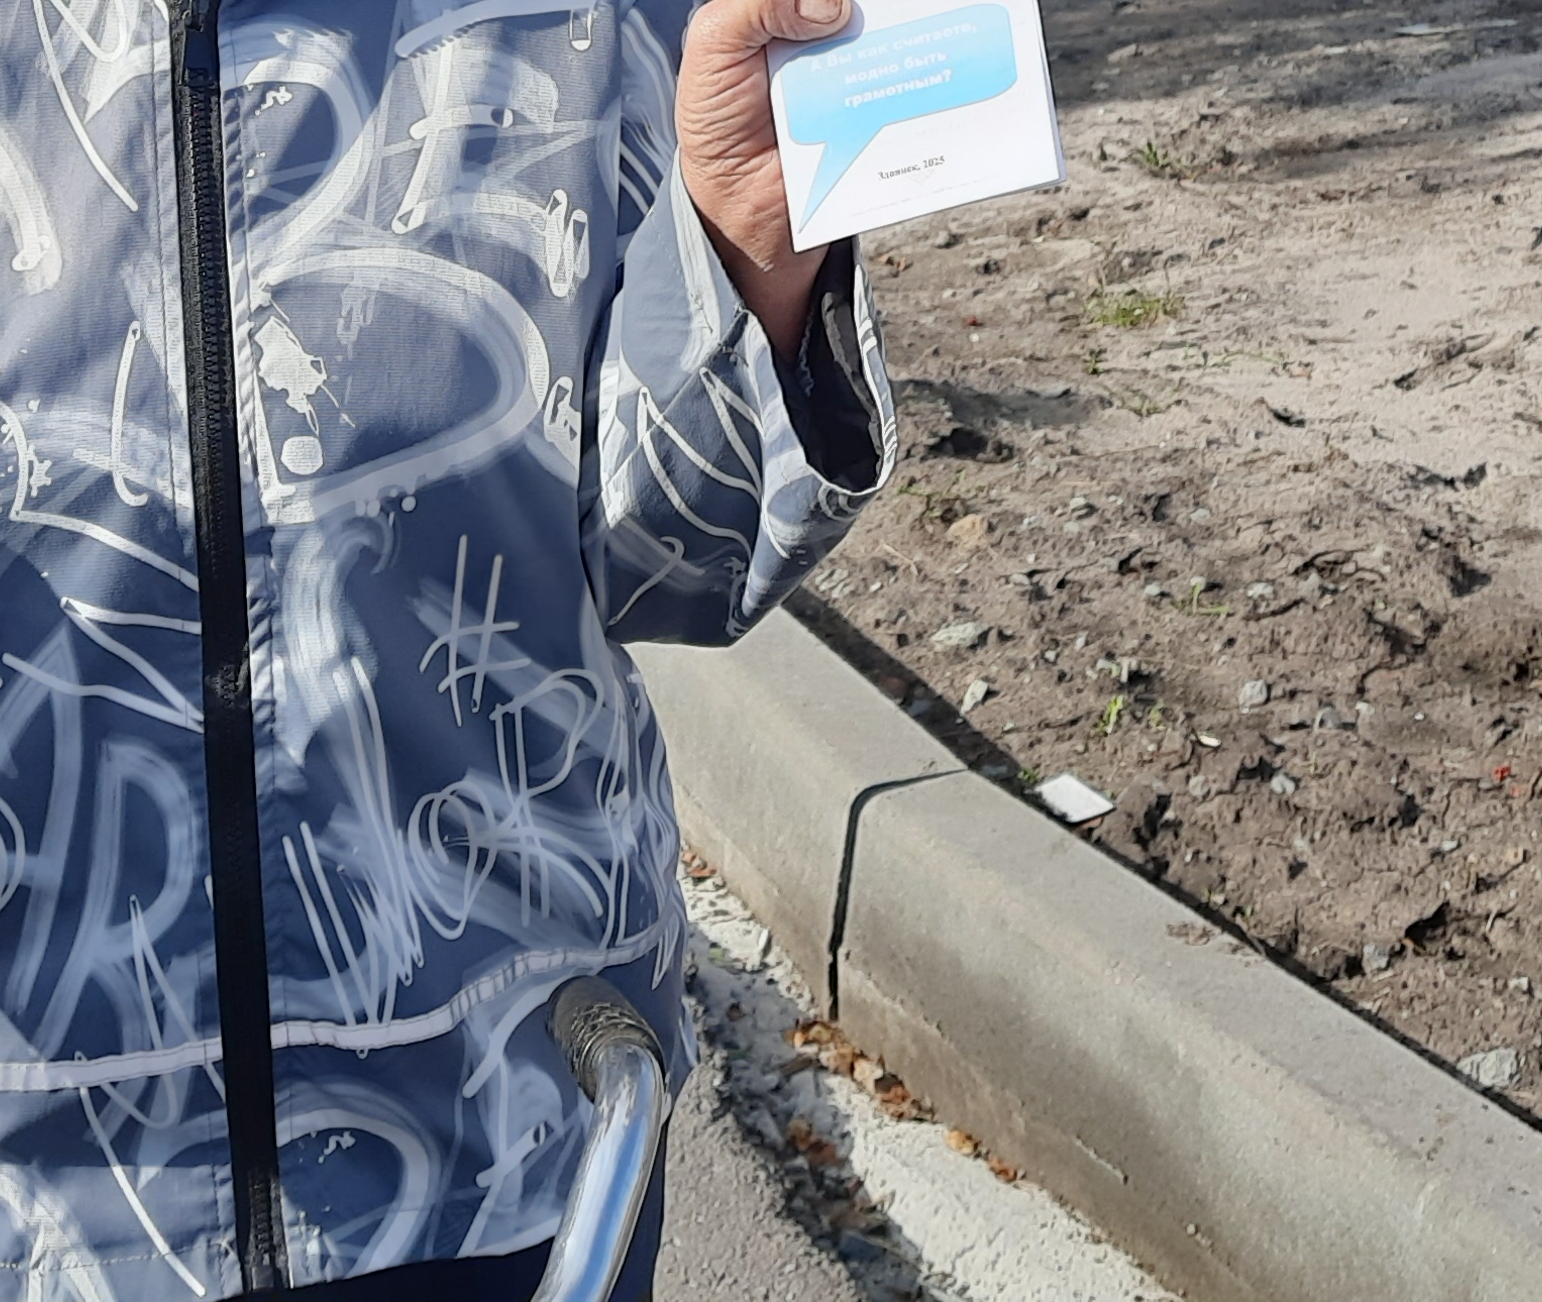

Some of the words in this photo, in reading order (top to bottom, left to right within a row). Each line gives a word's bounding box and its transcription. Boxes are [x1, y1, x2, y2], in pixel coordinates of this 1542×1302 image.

[810, 60, 822, 73] А
[827, 52, 852, 68] Вы
[857, 43, 889, 60] как
[892, 22, 977, 51] считаете,
[844, 62, 900, 86] модно
[904, 50, 948, 70] быть
[843, 69, 953, 109] грамотным?
[922, 155, 945, 169] 2025
